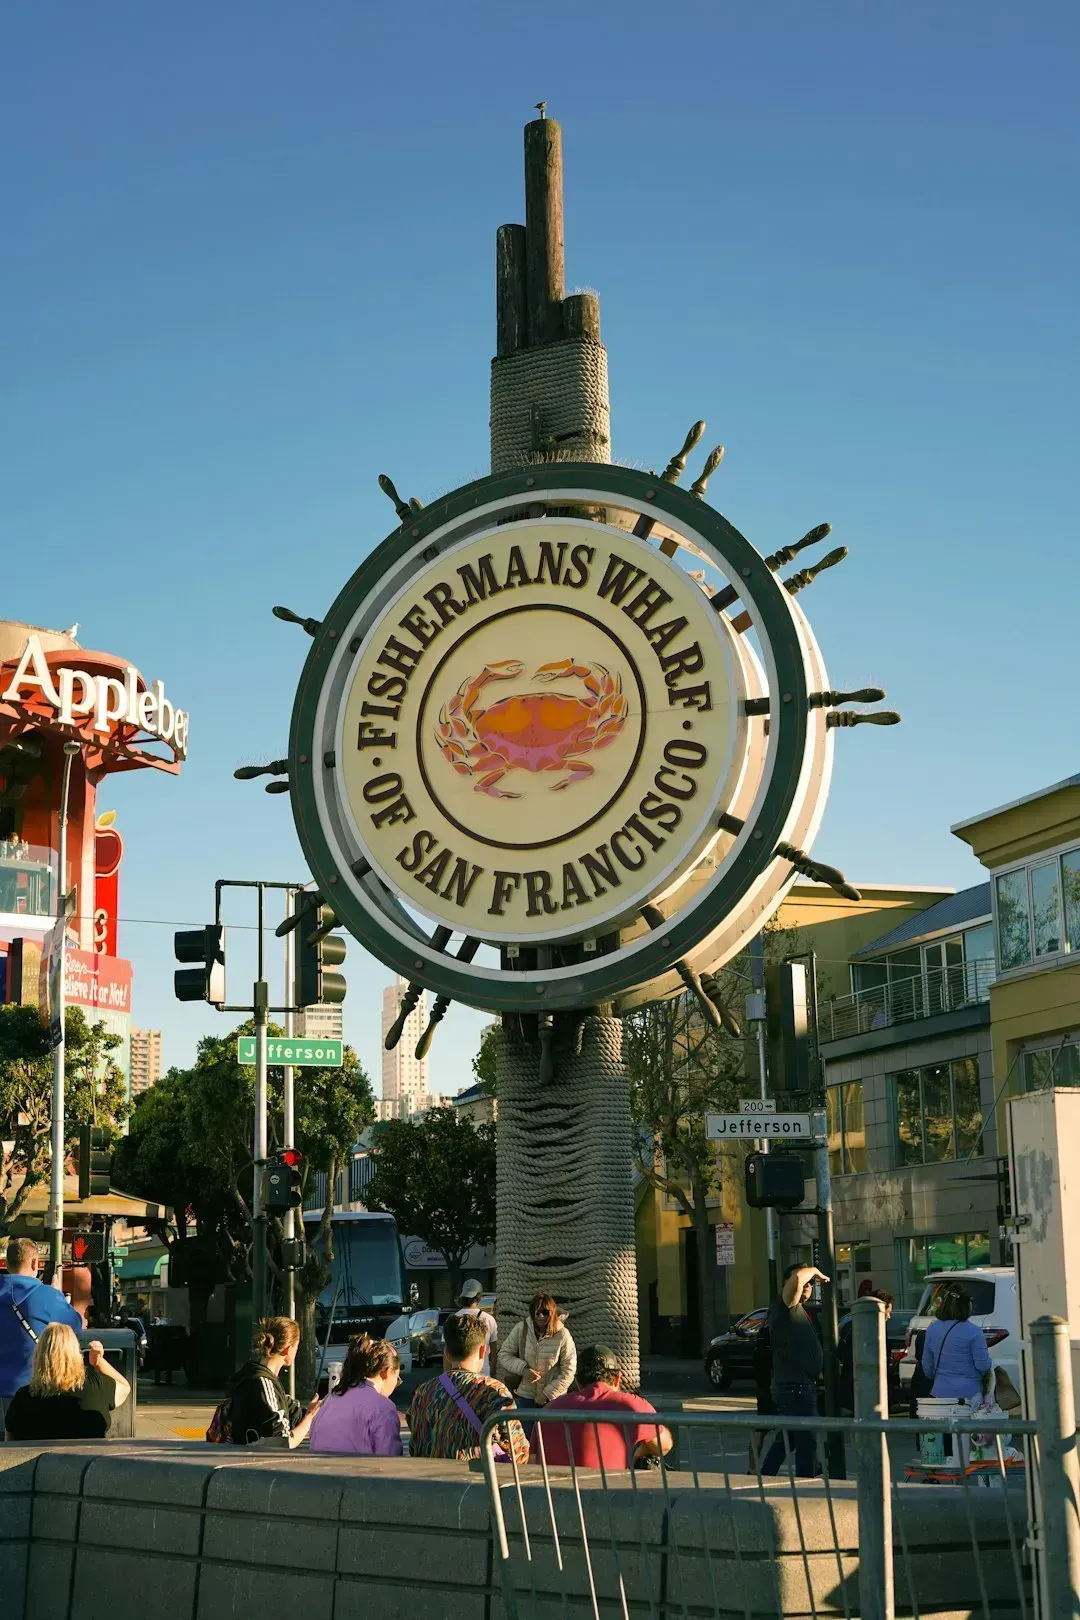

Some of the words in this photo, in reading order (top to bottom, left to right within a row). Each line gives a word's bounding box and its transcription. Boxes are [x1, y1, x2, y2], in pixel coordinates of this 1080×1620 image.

[357, 541, 597, 752] FISHERMANS
[596, 552, 713, 713] WHARF
[362, 772, 417, 829] OF
[395, 829, 484, 907] SAN
[487, 738, 709, 918] FRANCISCO
[64, 976, 89, 1000] elieve
[89, 978, 98, 1002] It
[98, 986, 109, 1004] or
[109, 982, 128, 1008] Not!
[244, 1043, 336, 1059] Jfferson
[743, 1102, 764, 1111] 200
[717, 1119, 802, 1133] Jefferson
